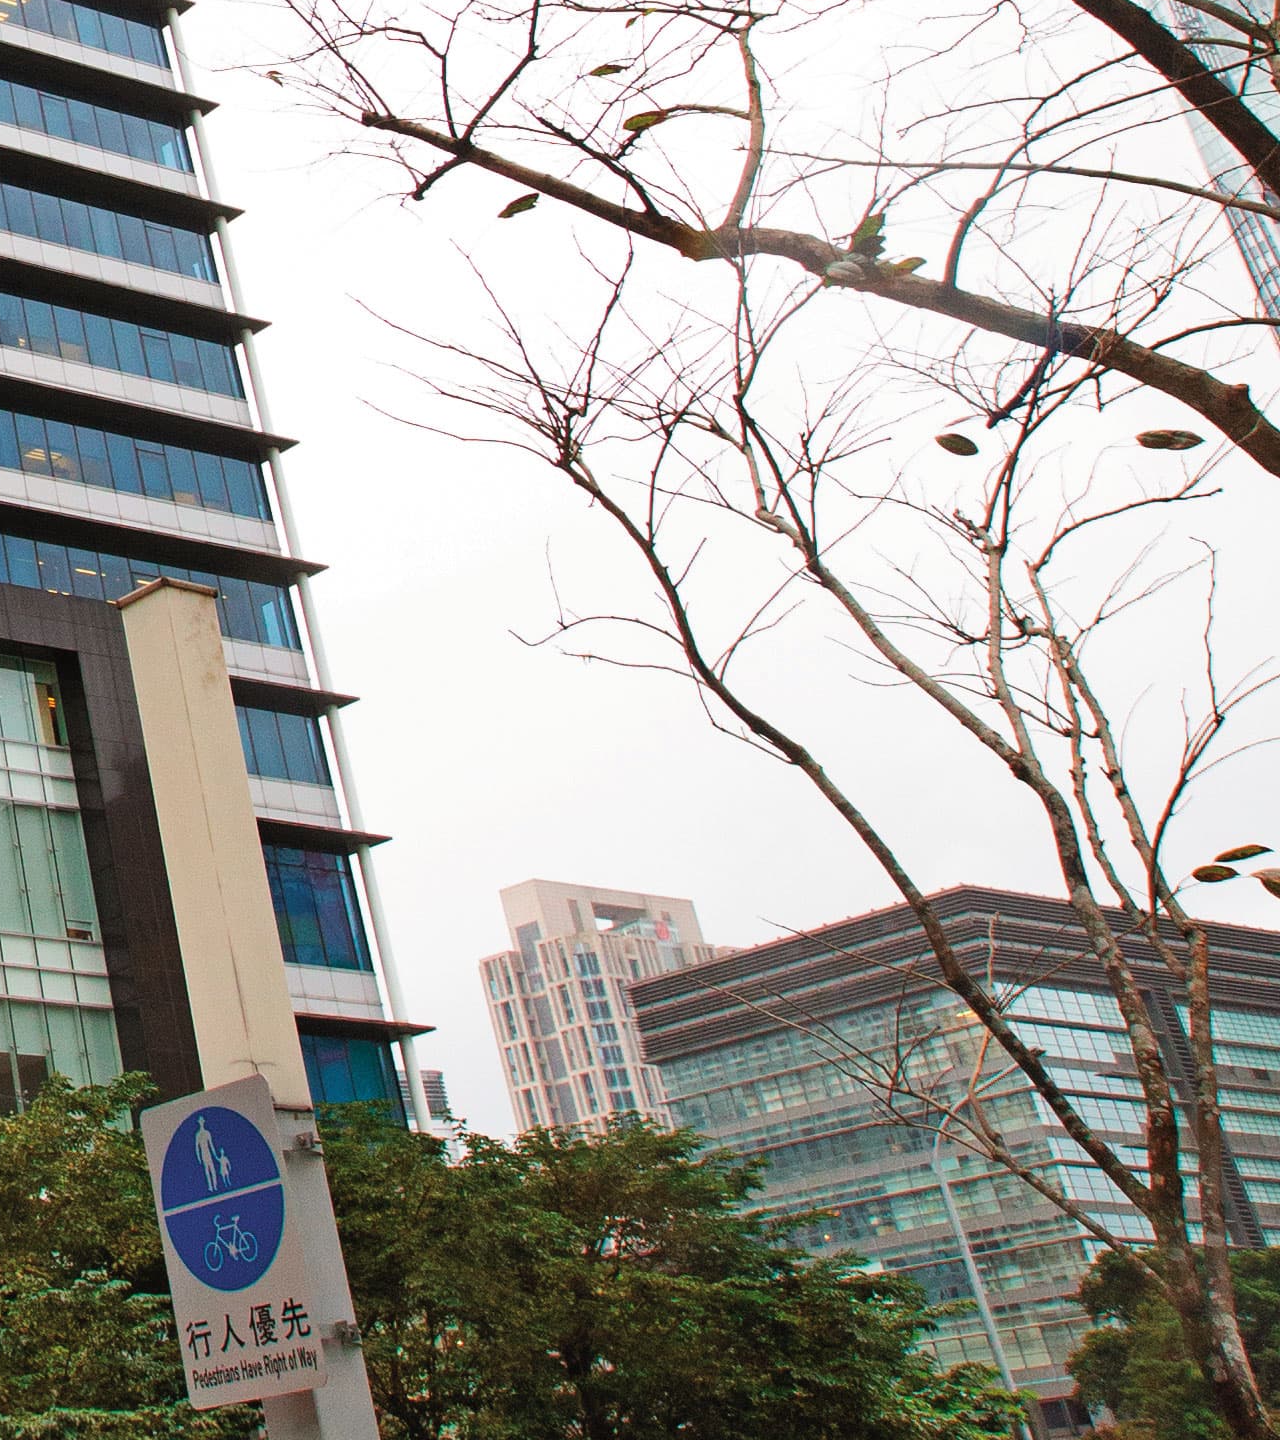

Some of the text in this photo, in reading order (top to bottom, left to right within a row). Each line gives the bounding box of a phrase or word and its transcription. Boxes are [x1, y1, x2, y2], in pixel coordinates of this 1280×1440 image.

[186, 1297, 311, 1360] 行人優先
[192, 1346, 318, 1390] Pedestrians Have Right of Way
